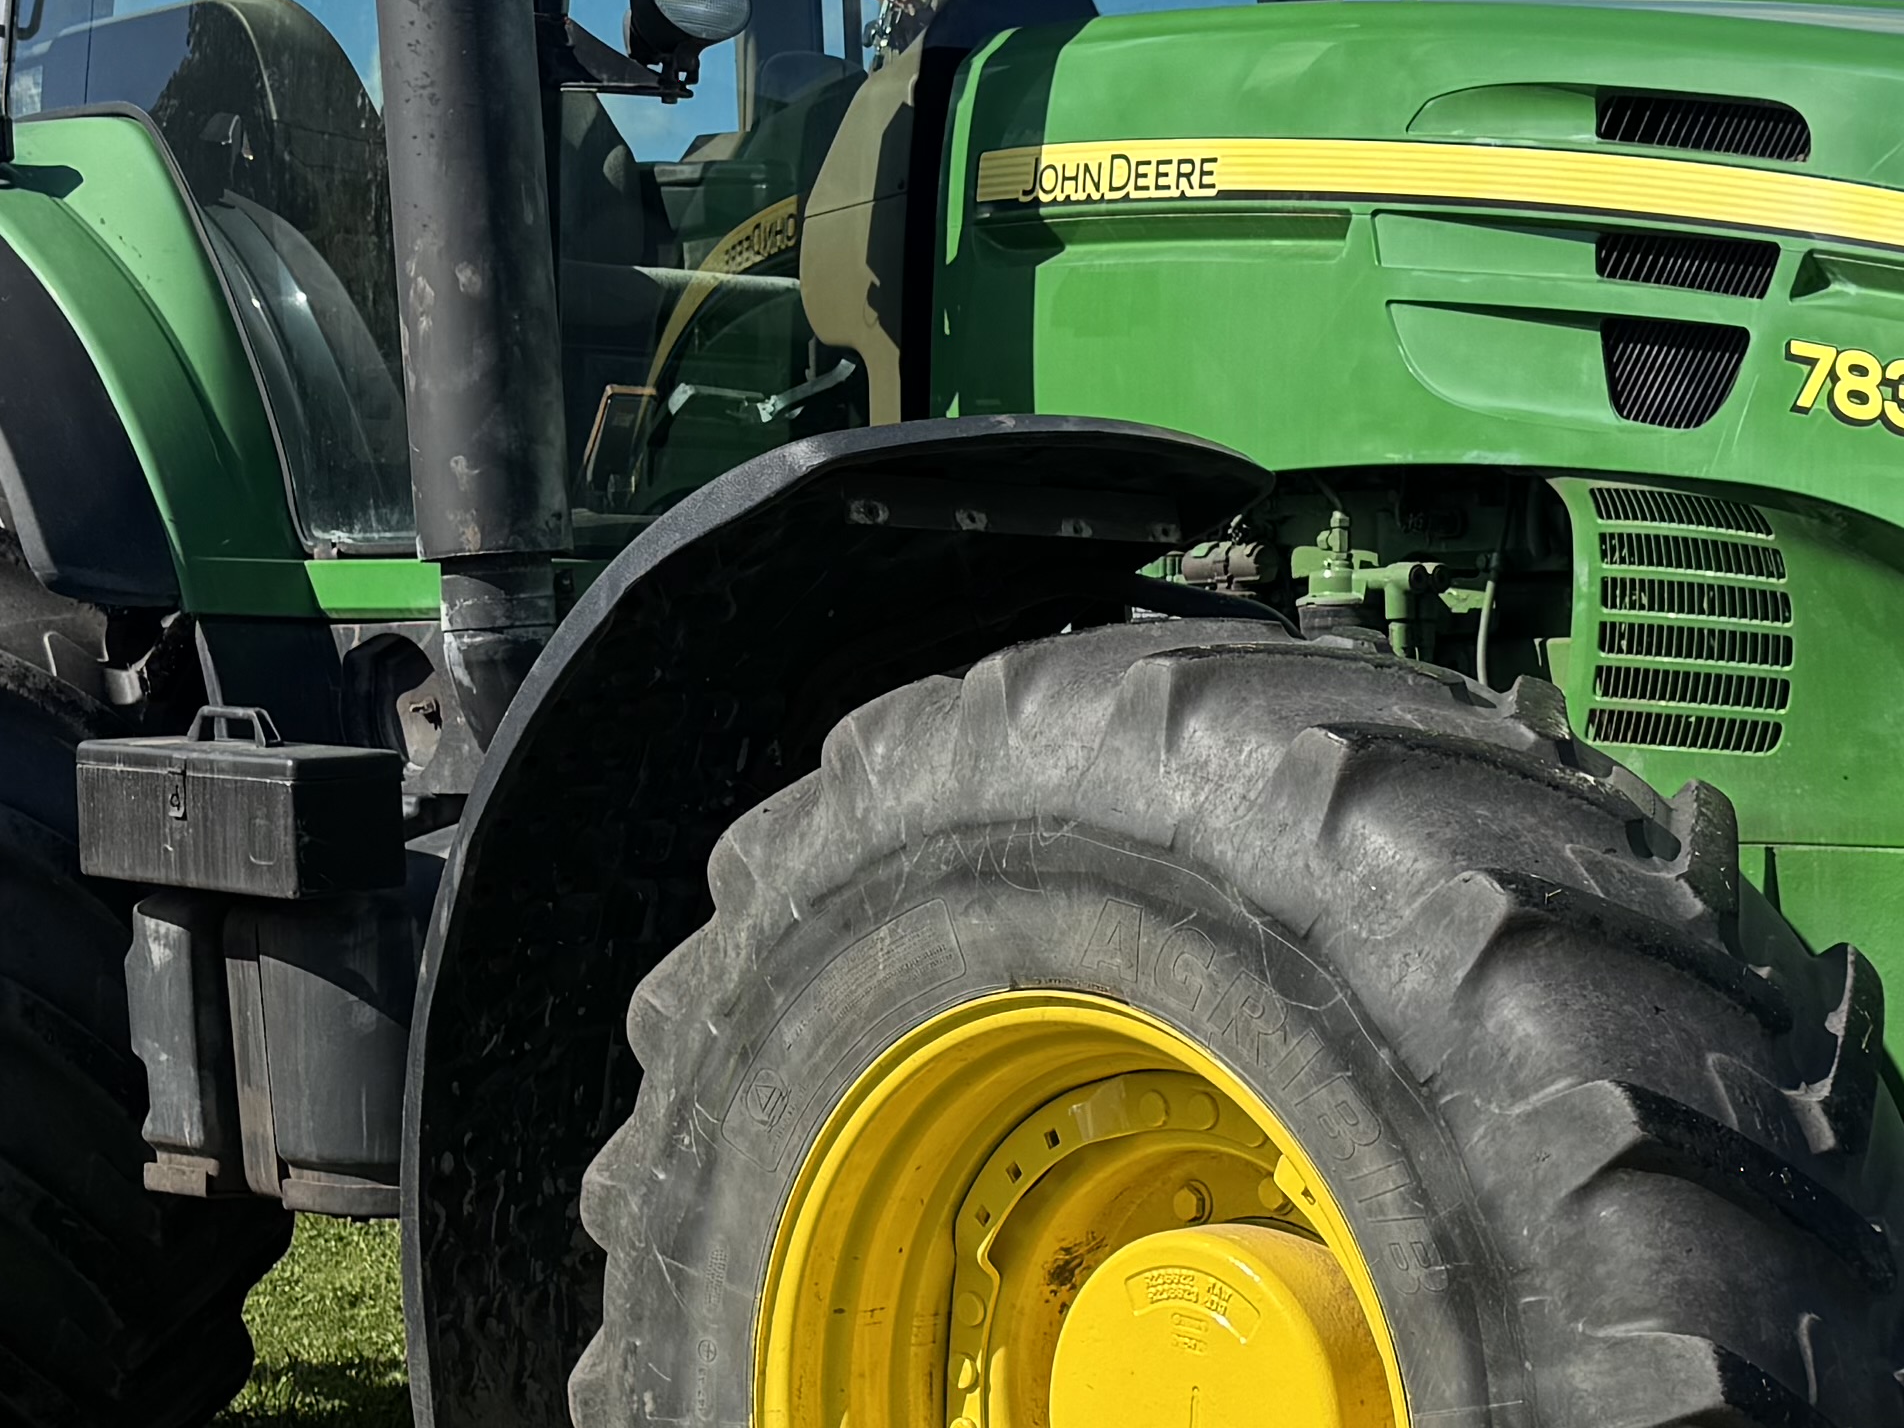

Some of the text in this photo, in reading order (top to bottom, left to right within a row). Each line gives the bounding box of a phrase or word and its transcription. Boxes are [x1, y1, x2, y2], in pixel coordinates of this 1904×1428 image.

[1021, 154, 1218, 195] JOHN DEERE
[1080, 897, 1450, 1297] AGRIBIB
